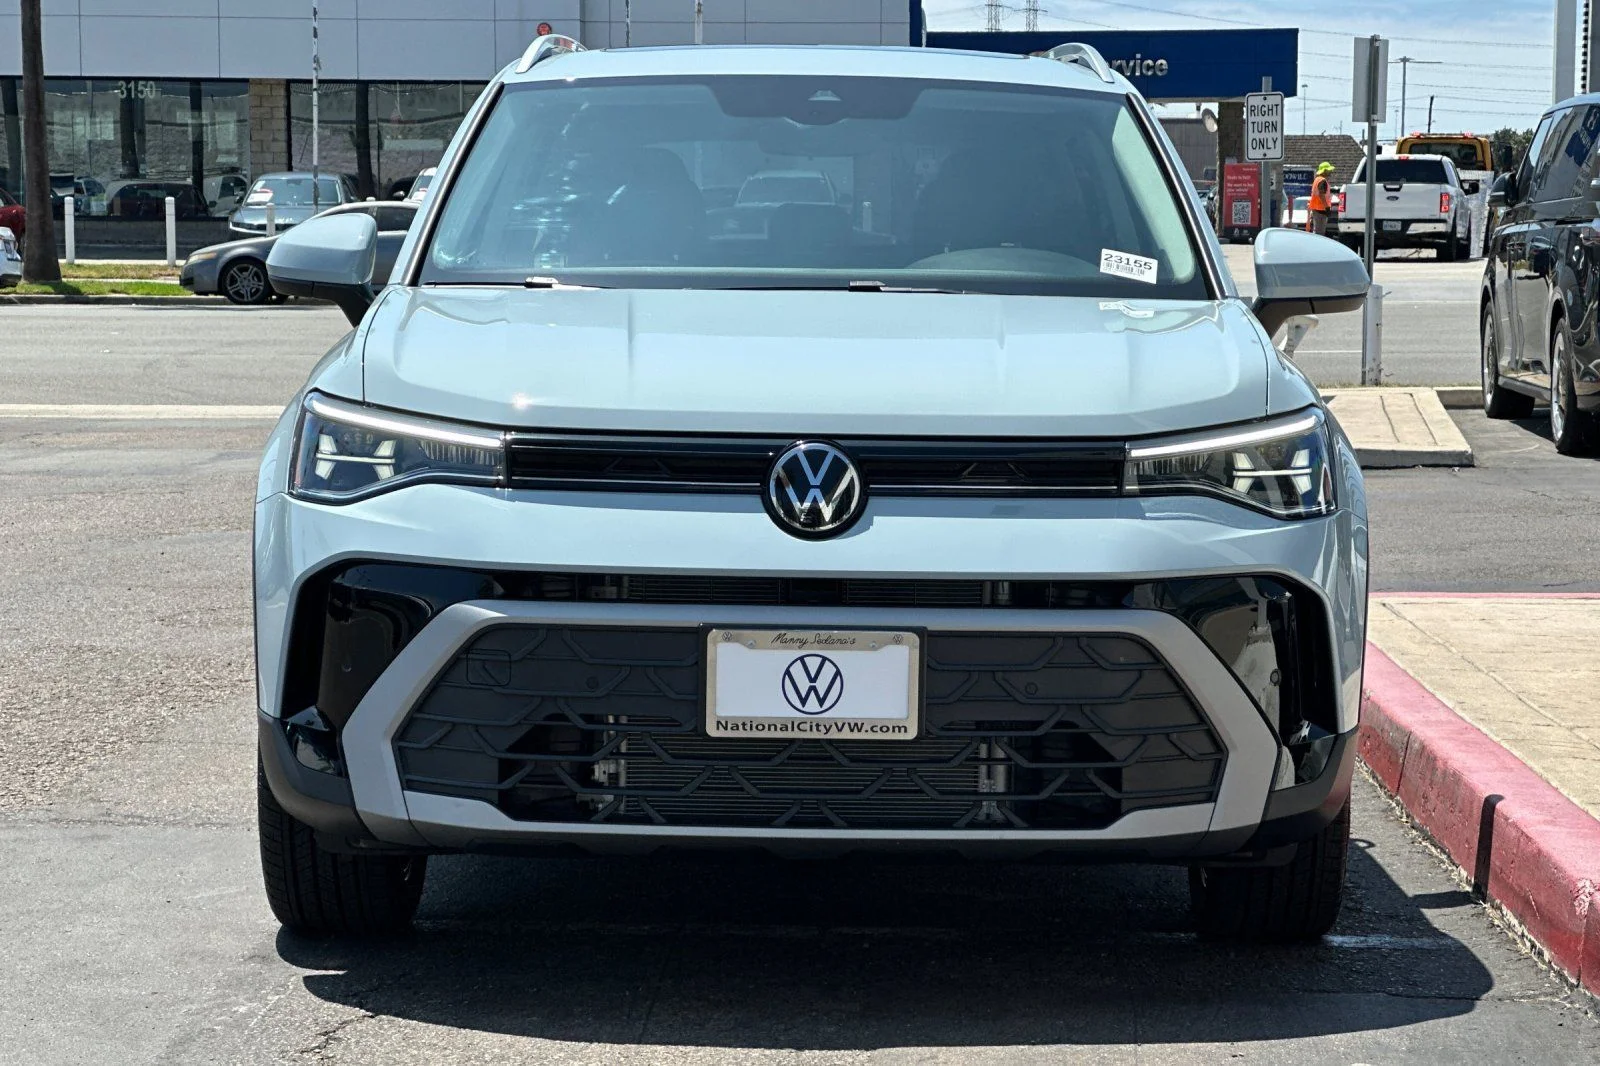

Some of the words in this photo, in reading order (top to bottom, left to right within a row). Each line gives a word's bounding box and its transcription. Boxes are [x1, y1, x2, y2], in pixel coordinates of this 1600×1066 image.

[118, 80, 156, 99] 3150
[1250, 104, 1280, 117] RIGHT
[1251, 121, 1278, 134] TURN
[1251, 137, 1278, 150] ONLY
[1103, 253, 1153, 271] 23155
[771, 632, 809, 649] Manny
[715, 719, 908, 736] NationalCityVW.com
